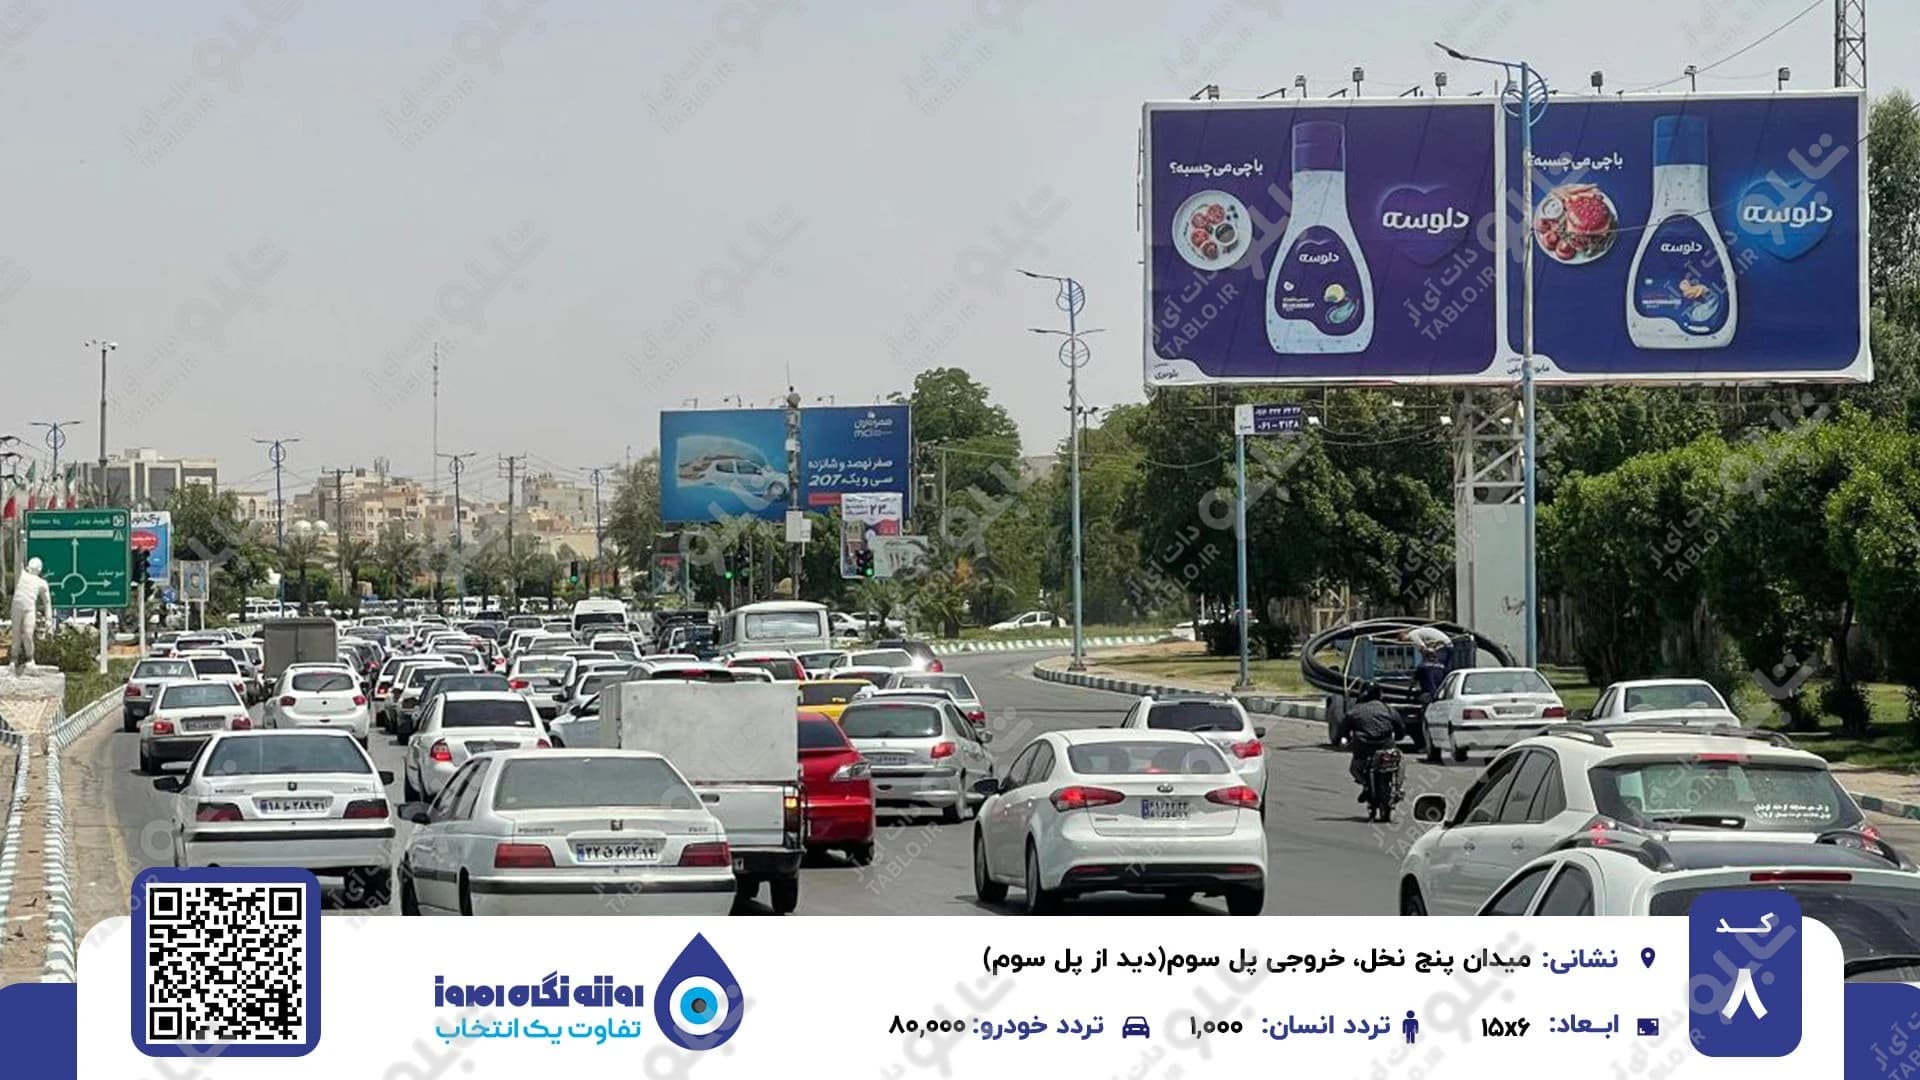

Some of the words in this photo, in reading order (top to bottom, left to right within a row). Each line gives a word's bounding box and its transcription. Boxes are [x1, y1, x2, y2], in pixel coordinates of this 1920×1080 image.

[1382, 206, 1471, 234] دلوسه
[1744, 200, 1834, 229] دلوسه
[1660, 241, 1703, 255] دلوسه
[1298, 250, 1341, 266] دلوسه
[807, 457, 839, 472] شانزده
[847, 457, 873, 471] نهصد
[871, 456, 894, 471] صفر
[808, 474, 842, 487] 207
[869, 476, 894, 487] سی
